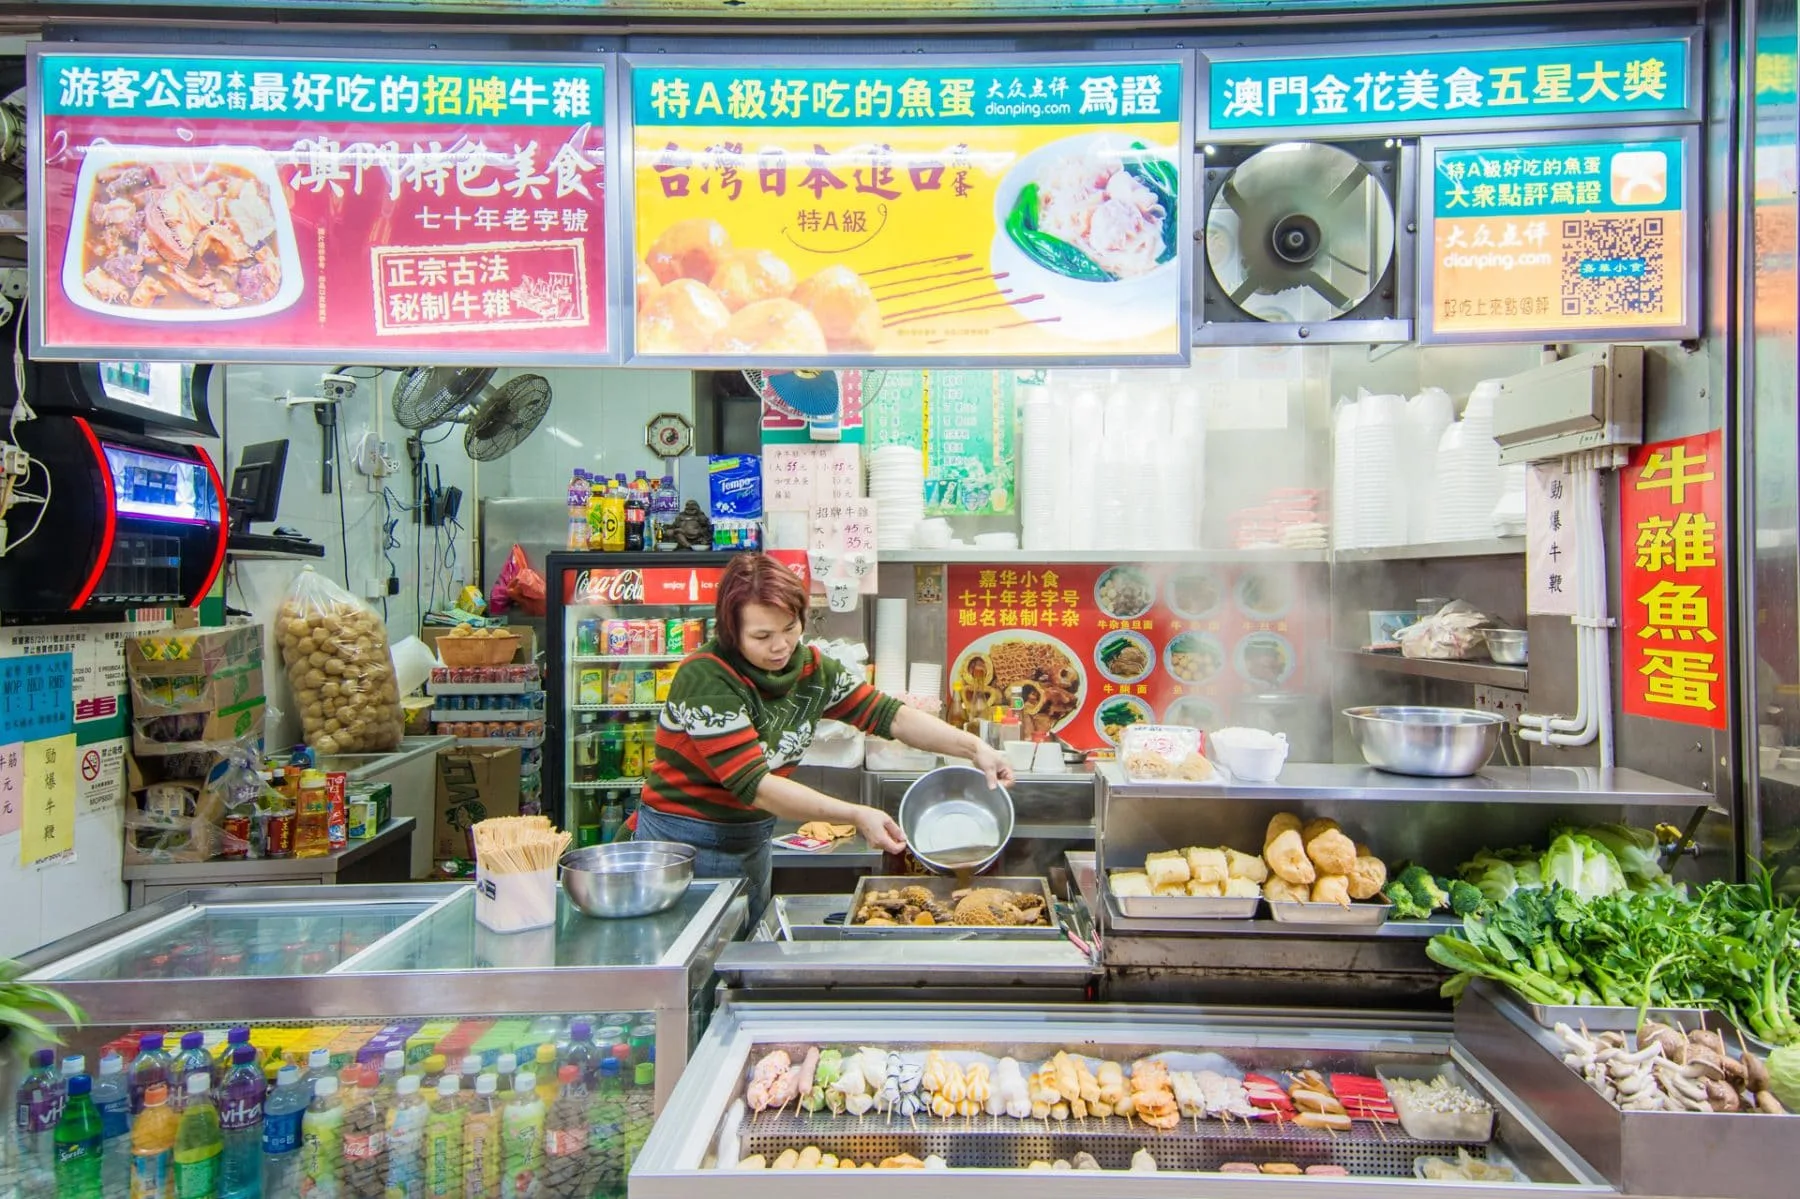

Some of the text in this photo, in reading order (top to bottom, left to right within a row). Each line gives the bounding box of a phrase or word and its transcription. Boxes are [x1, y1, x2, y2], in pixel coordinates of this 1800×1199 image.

[651, 77, 976, 119] 特A級好吃的魚蛋
[985, 76, 1070, 100] 大众点评
[1223, 57, 1668, 118] 澳門金花美食五星大獎
[985, 102, 1071, 117] dianping.com
[289, 134, 597, 201] 澳門特色美食
[1447, 156, 1601, 180] 特A級好吃的魚蛋
[414, 206, 589, 233] 七十年老字號
[796, 208, 868, 233] 特A級
[1445, 221, 1550, 249] 大众点评
[386, 254, 510, 288] 正宗古法
[1443, 252, 1552, 271] dianping.com
[389, 288, 512, 322] 秘制牛雜
[718, 477, 752, 493] Tempo
[662, 581, 686, 591] enjoy
[979, 569, 1060, 588] 嘉华小食
[1635, 445, 1719, 712] 牛雜魚蛋
[959, 589, 1080, 608] 七十年老字号
[959, 608, 1080, 628] 驰名秘制牛杂
[220, 1099, 263, 1124] vita
